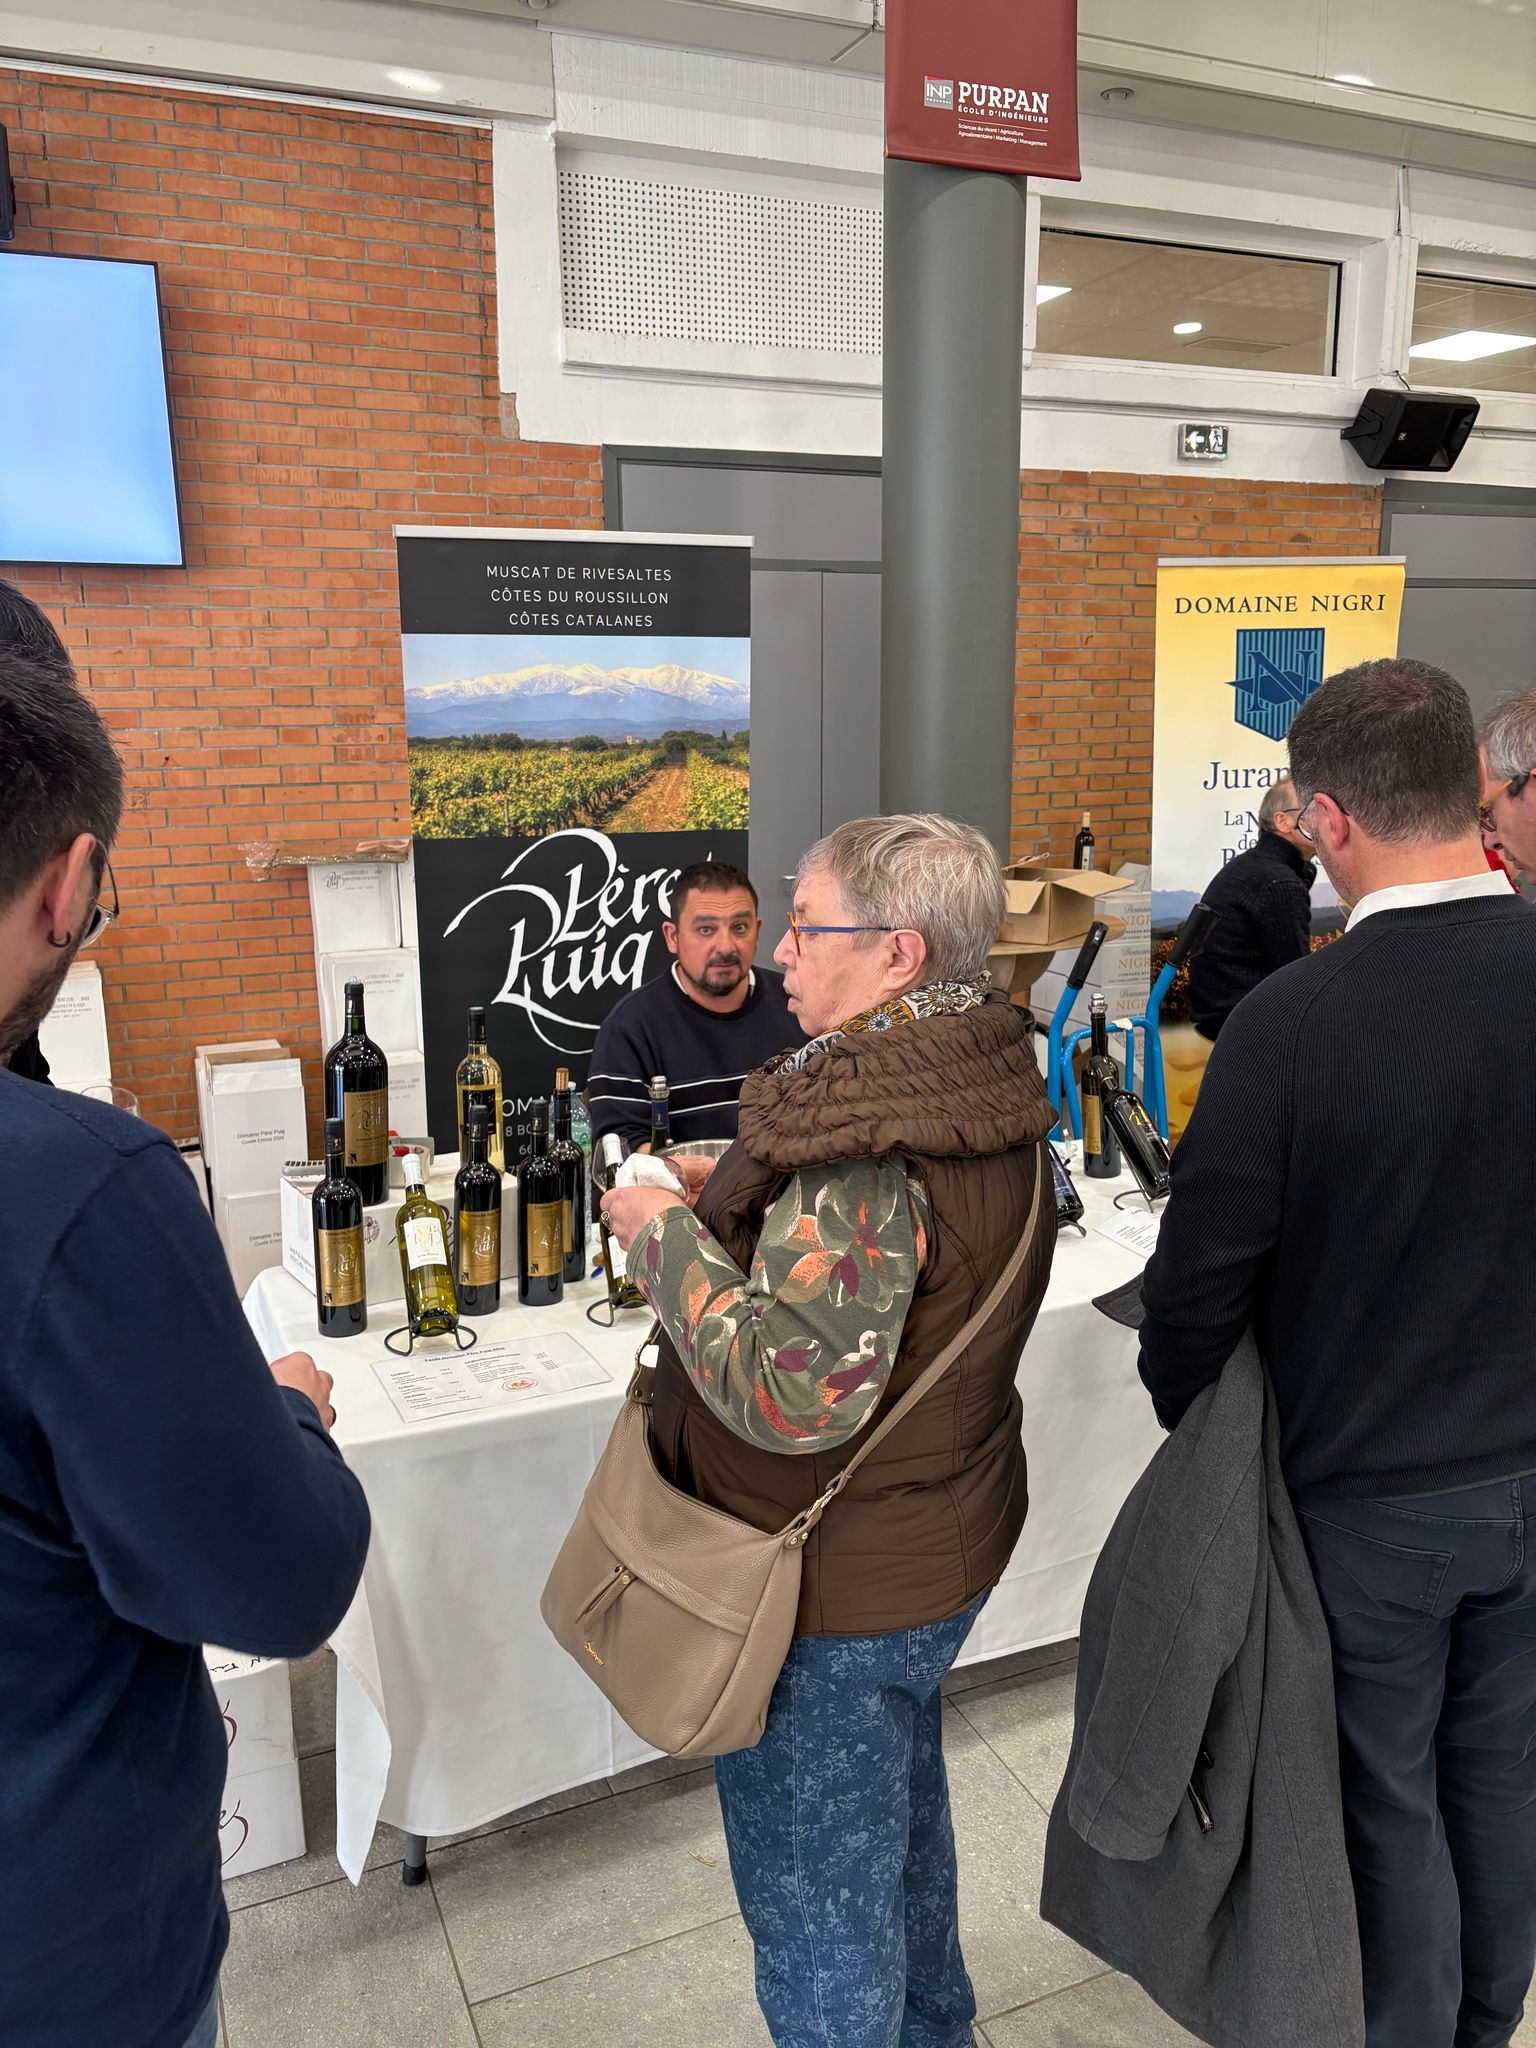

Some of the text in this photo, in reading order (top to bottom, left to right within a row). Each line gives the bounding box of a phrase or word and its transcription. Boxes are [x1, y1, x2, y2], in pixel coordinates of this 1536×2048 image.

[926, 83, 952, 99] INP
[958, 81, 1049, 114] PURPAN
[958, 105, 1049, 124] ÉCOLE D'INGÉNIEURS
[958, 123, 977, 131] Sciences
[1000, 129, 1024, 137] Agriculture
[996, 135, 1017, 144] Marketing
[1020, 138, 1048, 147] Management
[486, 565, 672, 581] MUSCAT DE RIVESALTES
[491, 587, 669, 604] CÔTES DU ROUSSILLON
[1175, 594, 1386, 614] DOMAINE NIGRI
[509, 610, 653, 627] CÔTES CATALANES
[1224, 810, 1244, 826] La
